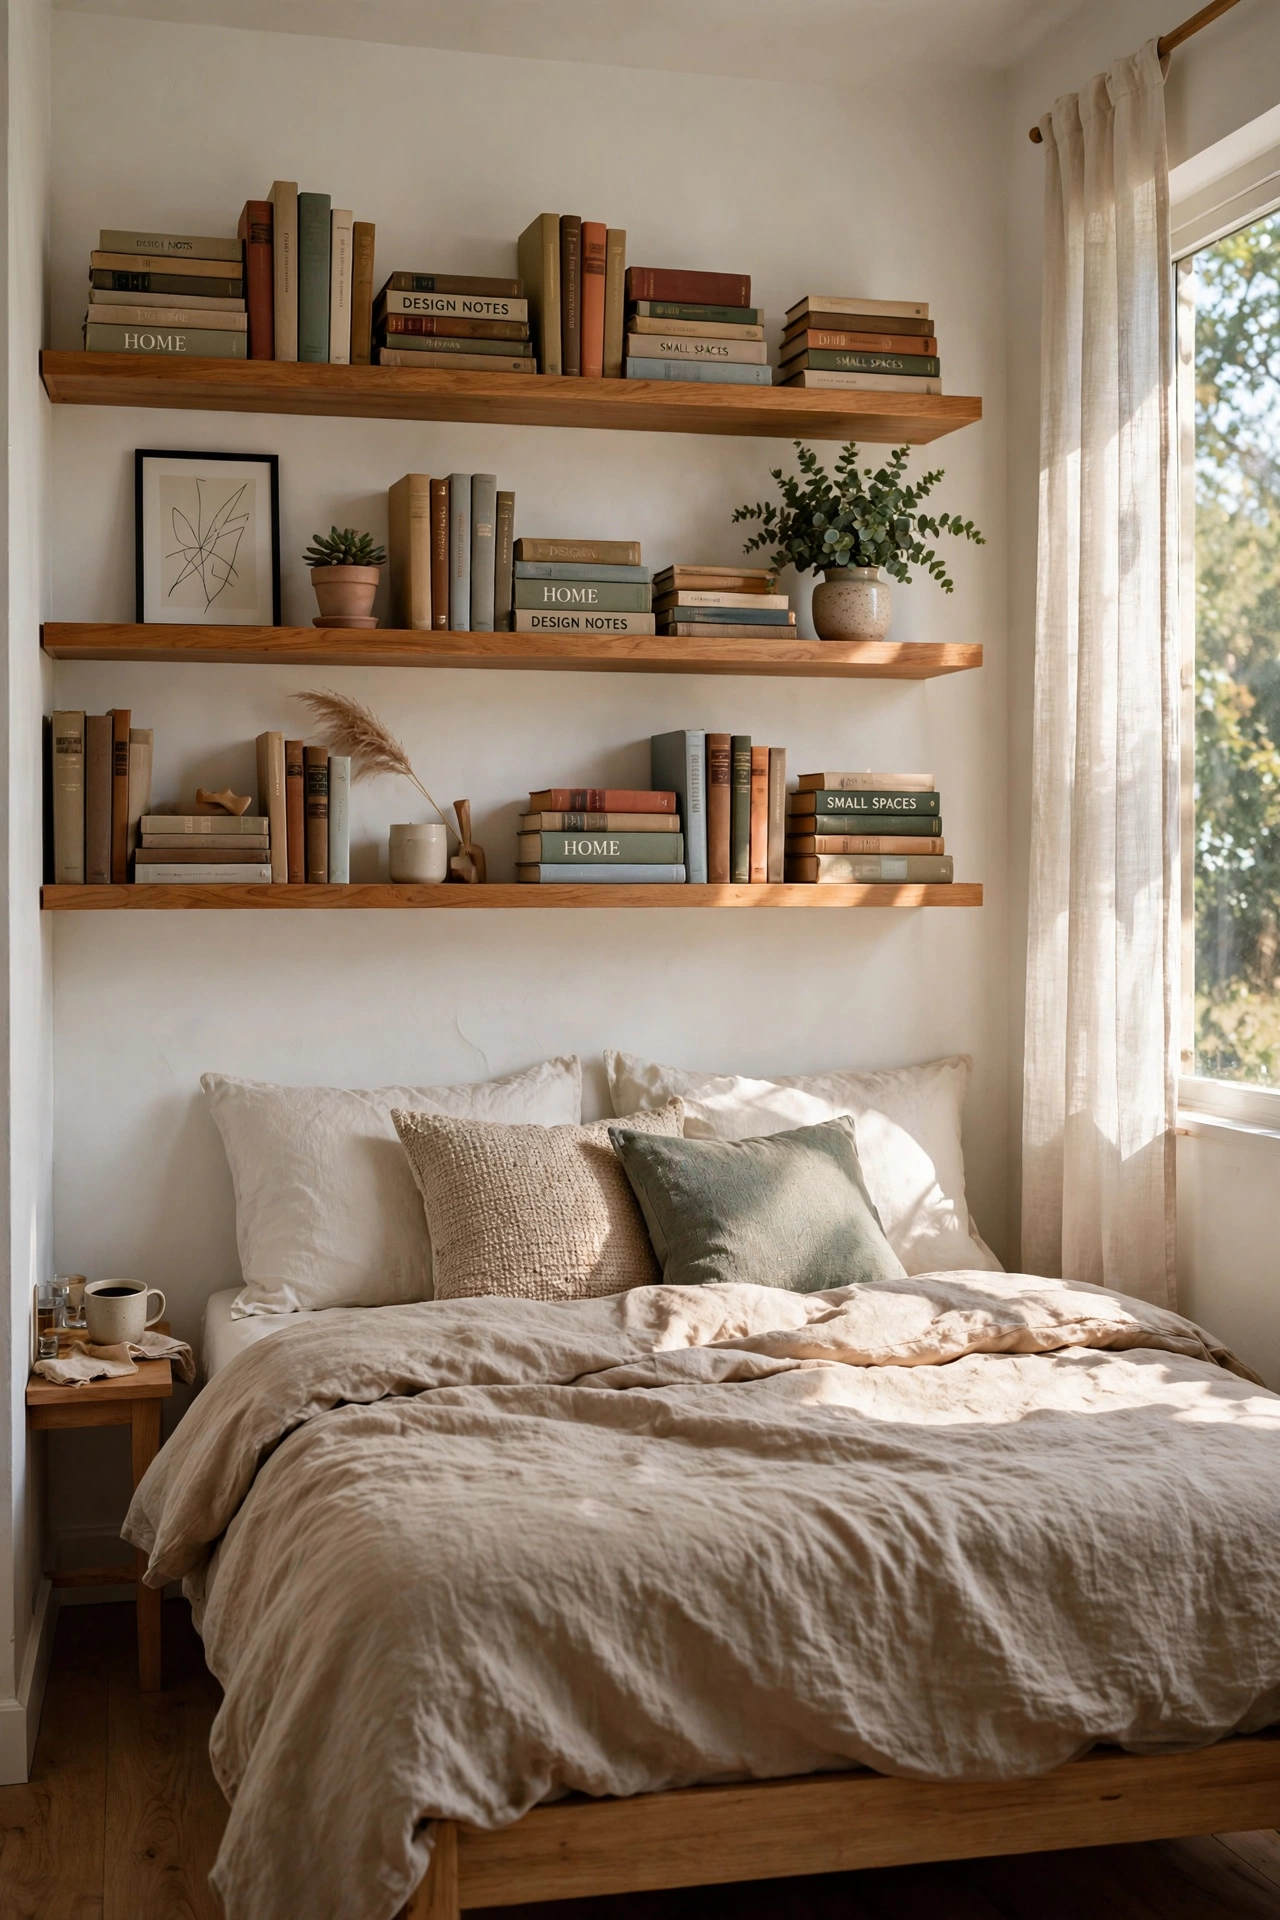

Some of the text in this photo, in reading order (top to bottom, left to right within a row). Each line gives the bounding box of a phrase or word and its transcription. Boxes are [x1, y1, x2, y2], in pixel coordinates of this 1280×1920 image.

[402, 297, 509, 315] DESIGN NOTES
[124, 333, 187, 351] HOME
[660, 342, 689, 353] SMALL
[835, 356, 903, 369] SMALL SPACES
[543, 587, 599, 603] HOME
[531, 615, 628, 630] DESIGN NOTES
[827, 796, 917, 810] SMALL SPACES
[563, 840, 620, 856] HOME
